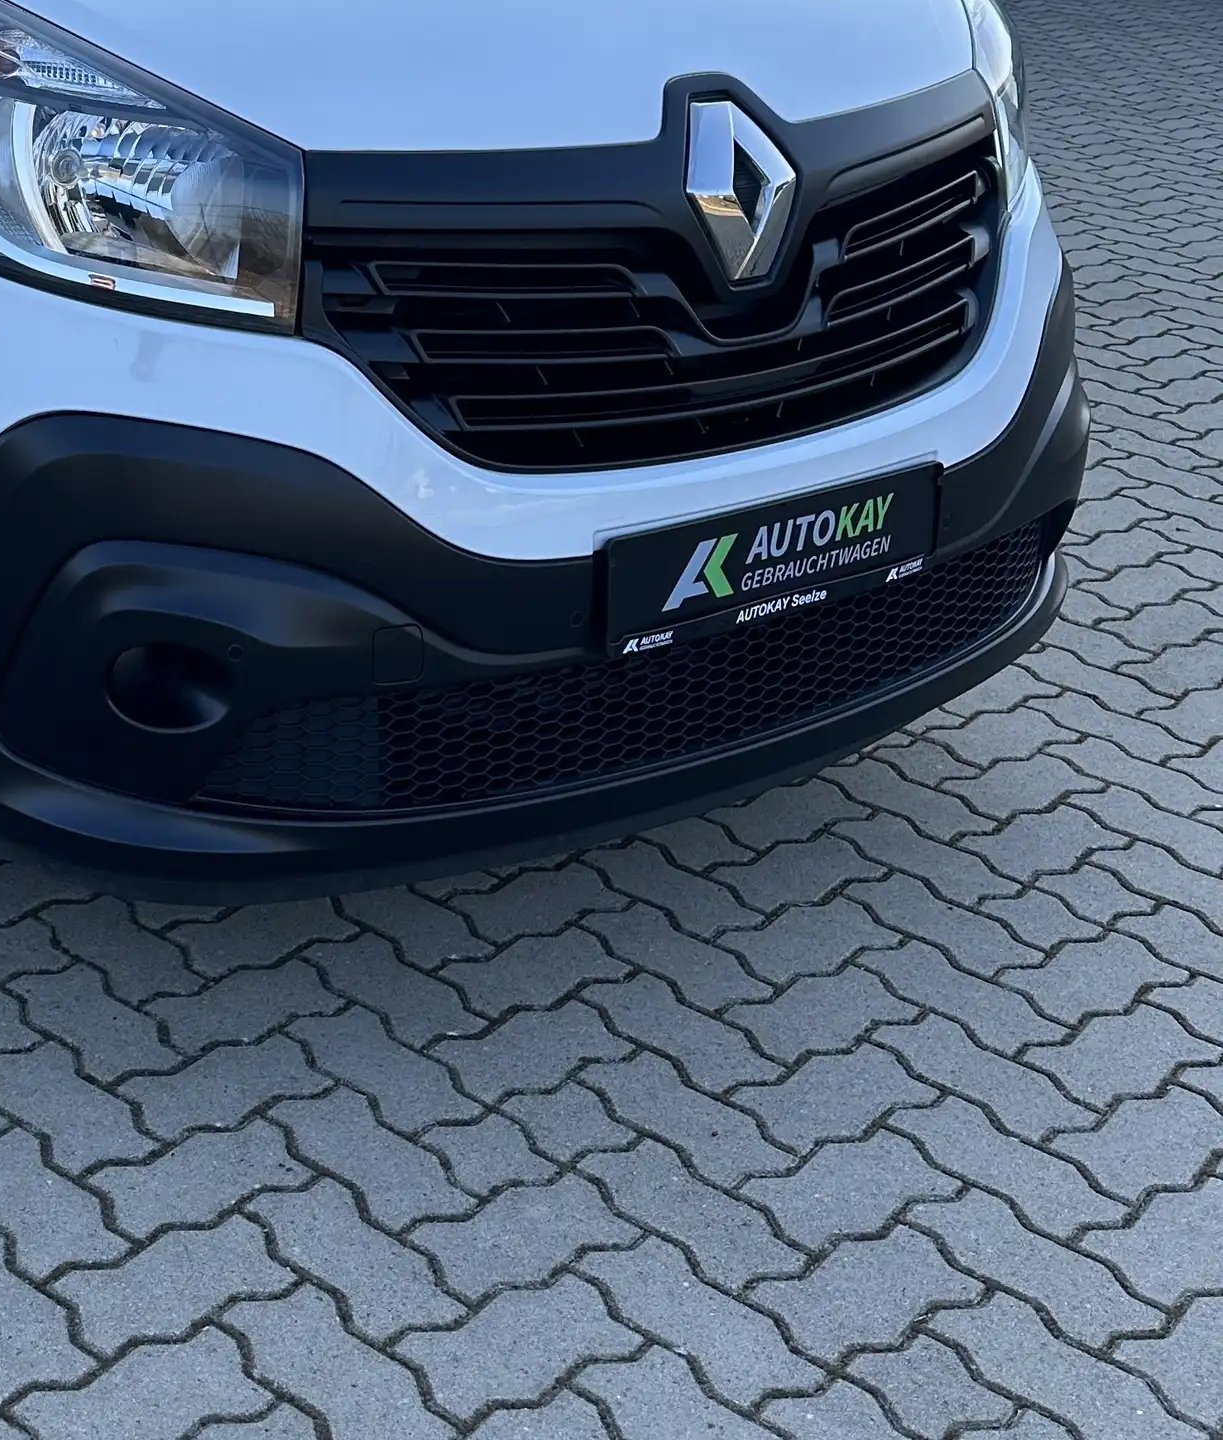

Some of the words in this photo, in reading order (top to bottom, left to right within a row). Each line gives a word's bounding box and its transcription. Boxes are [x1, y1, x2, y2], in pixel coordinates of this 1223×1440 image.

[745, 492, 895, 565] AUTOKAY
[741, 534, 891, 592] GEBRAUCHTWAGEN
[736, 596, 790, 624] AUTOKAY
[791, 589, 827, 607] Seelze
[640, 630, 674, 646] AUTOKAY
